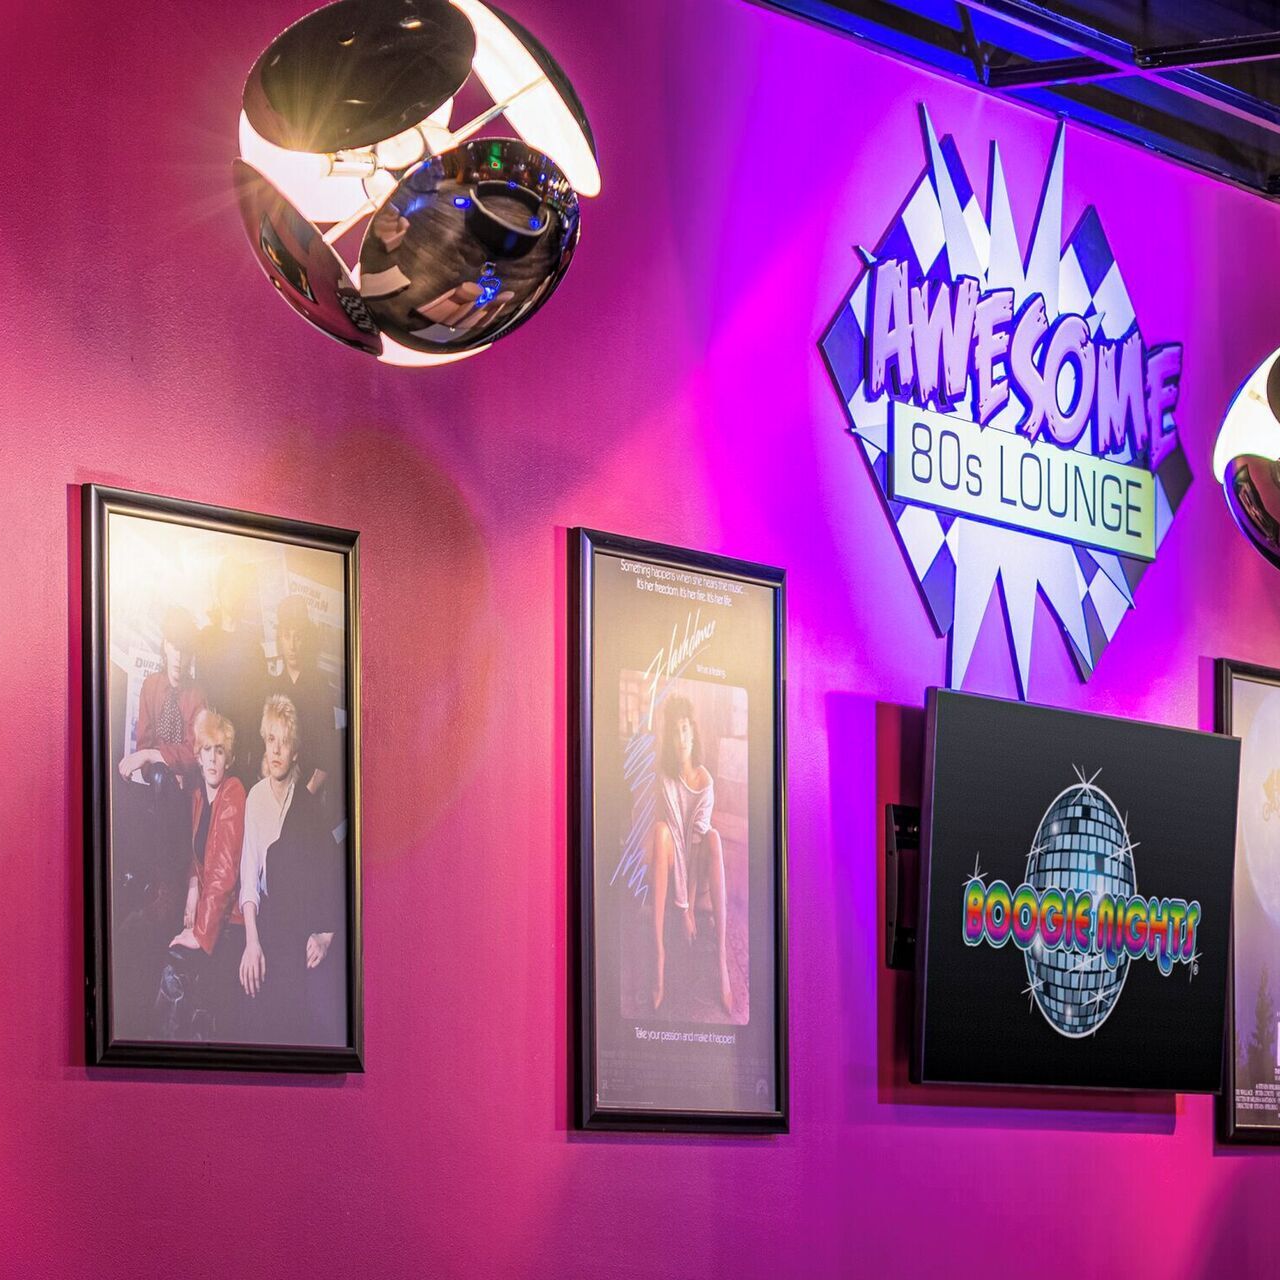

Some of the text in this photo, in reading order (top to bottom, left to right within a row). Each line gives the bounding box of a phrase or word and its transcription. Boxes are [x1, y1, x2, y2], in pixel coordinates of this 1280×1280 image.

[866, 256, 1185, 478] AWESOME
[910, 421, 1144, 539] 80s LOUNGE
[135, 656, 162, 672] DURA
[962, 878, 1202, 977] BOOGIE NIGHTS
